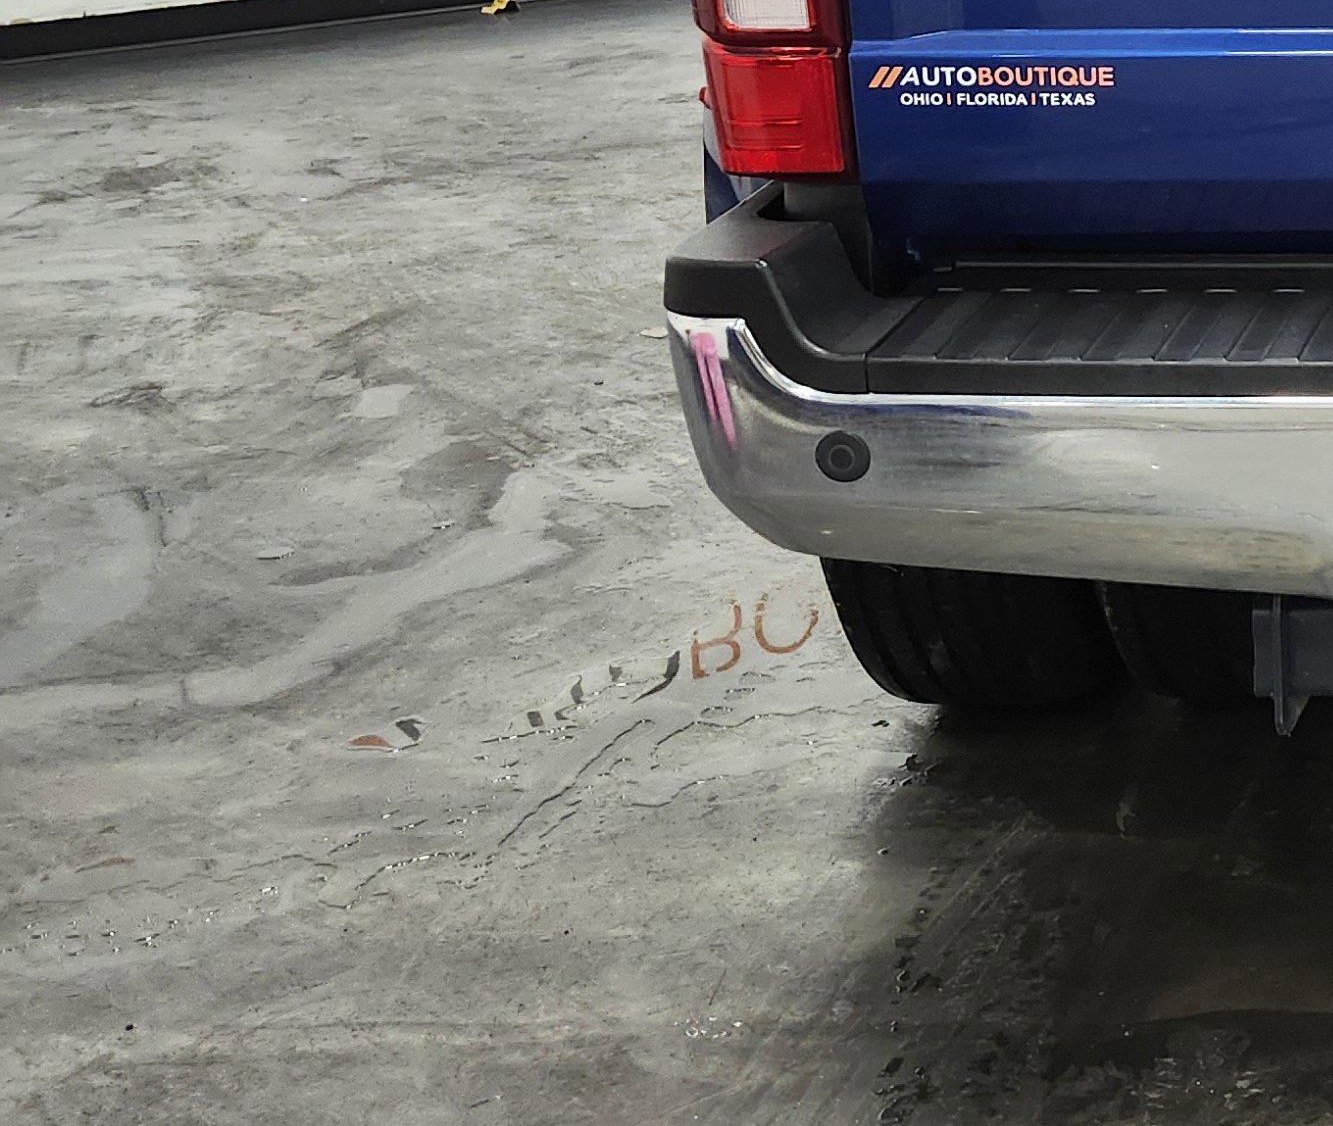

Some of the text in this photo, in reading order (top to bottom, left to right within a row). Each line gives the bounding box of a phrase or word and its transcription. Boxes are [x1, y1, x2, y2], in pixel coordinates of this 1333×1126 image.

[900, 65, 1115, 88] AUTOBOUTIQUE
[899, 92, 1096, 107] OHIO FLORIDA TEXAS
